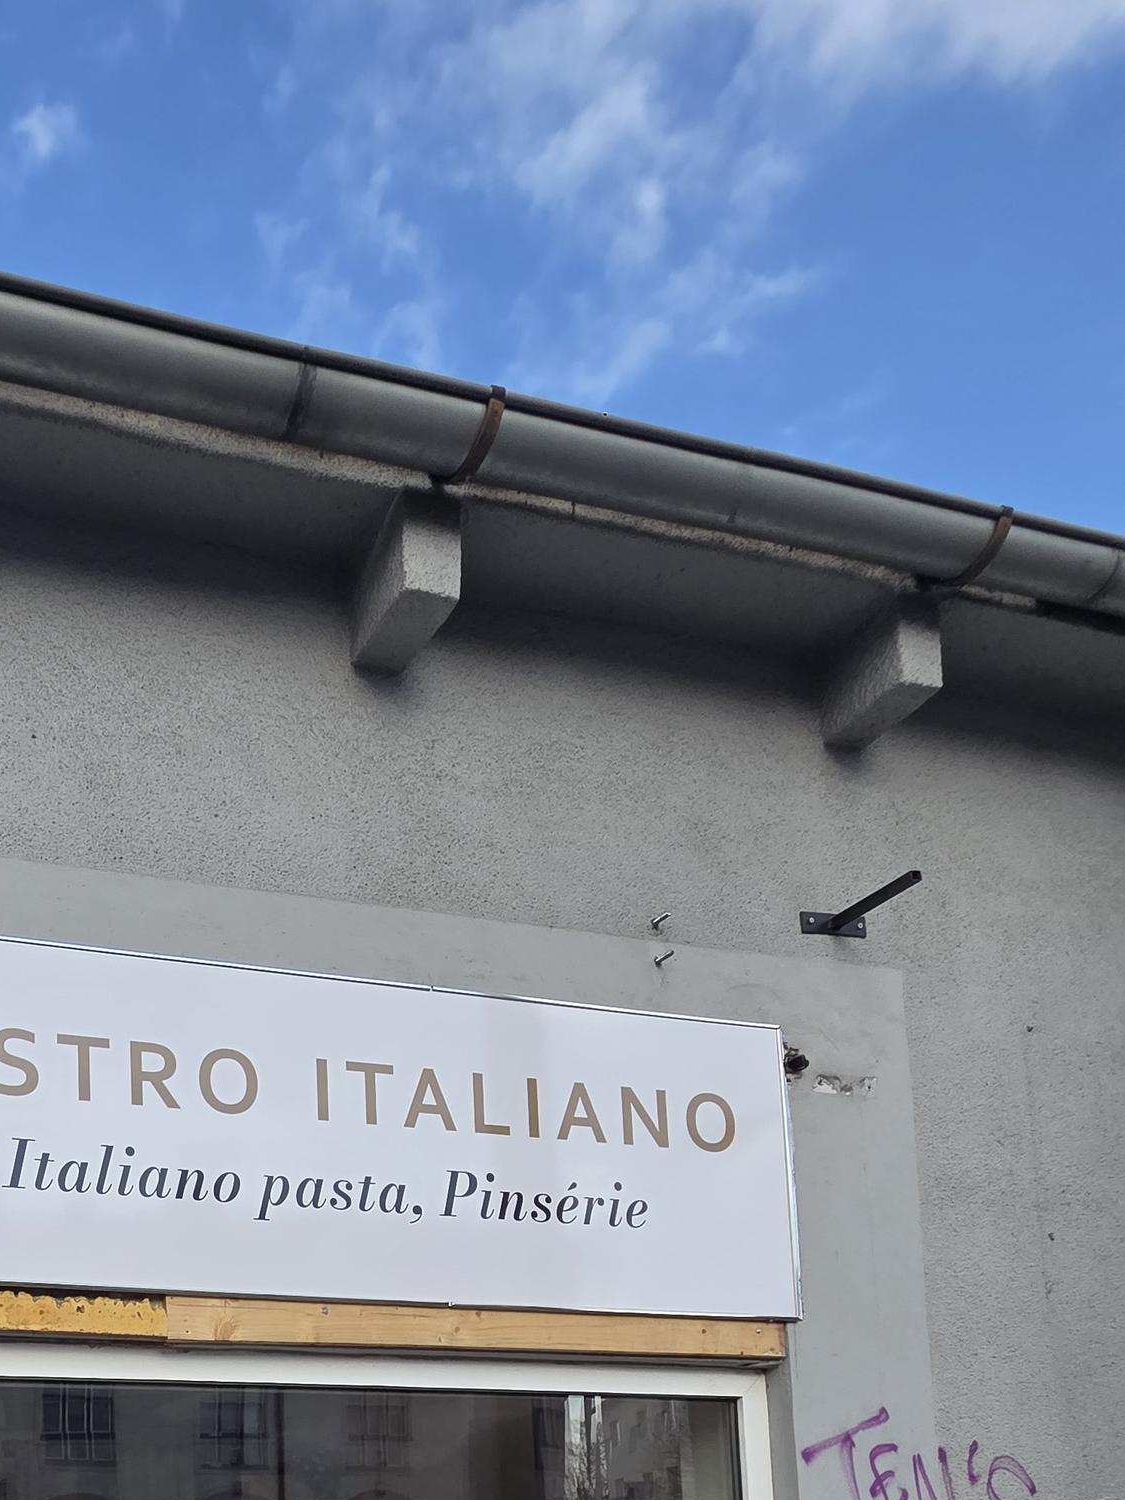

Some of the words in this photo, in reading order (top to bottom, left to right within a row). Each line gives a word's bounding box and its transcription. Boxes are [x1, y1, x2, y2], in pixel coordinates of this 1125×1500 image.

[316, 1057, 738, 1153] ITALIANO
[2, 1136, 242, 1205] Italiano
[253, 1170, 423, 1226] pasta,
[439, 1168, 650, 1231] Pinsérie
